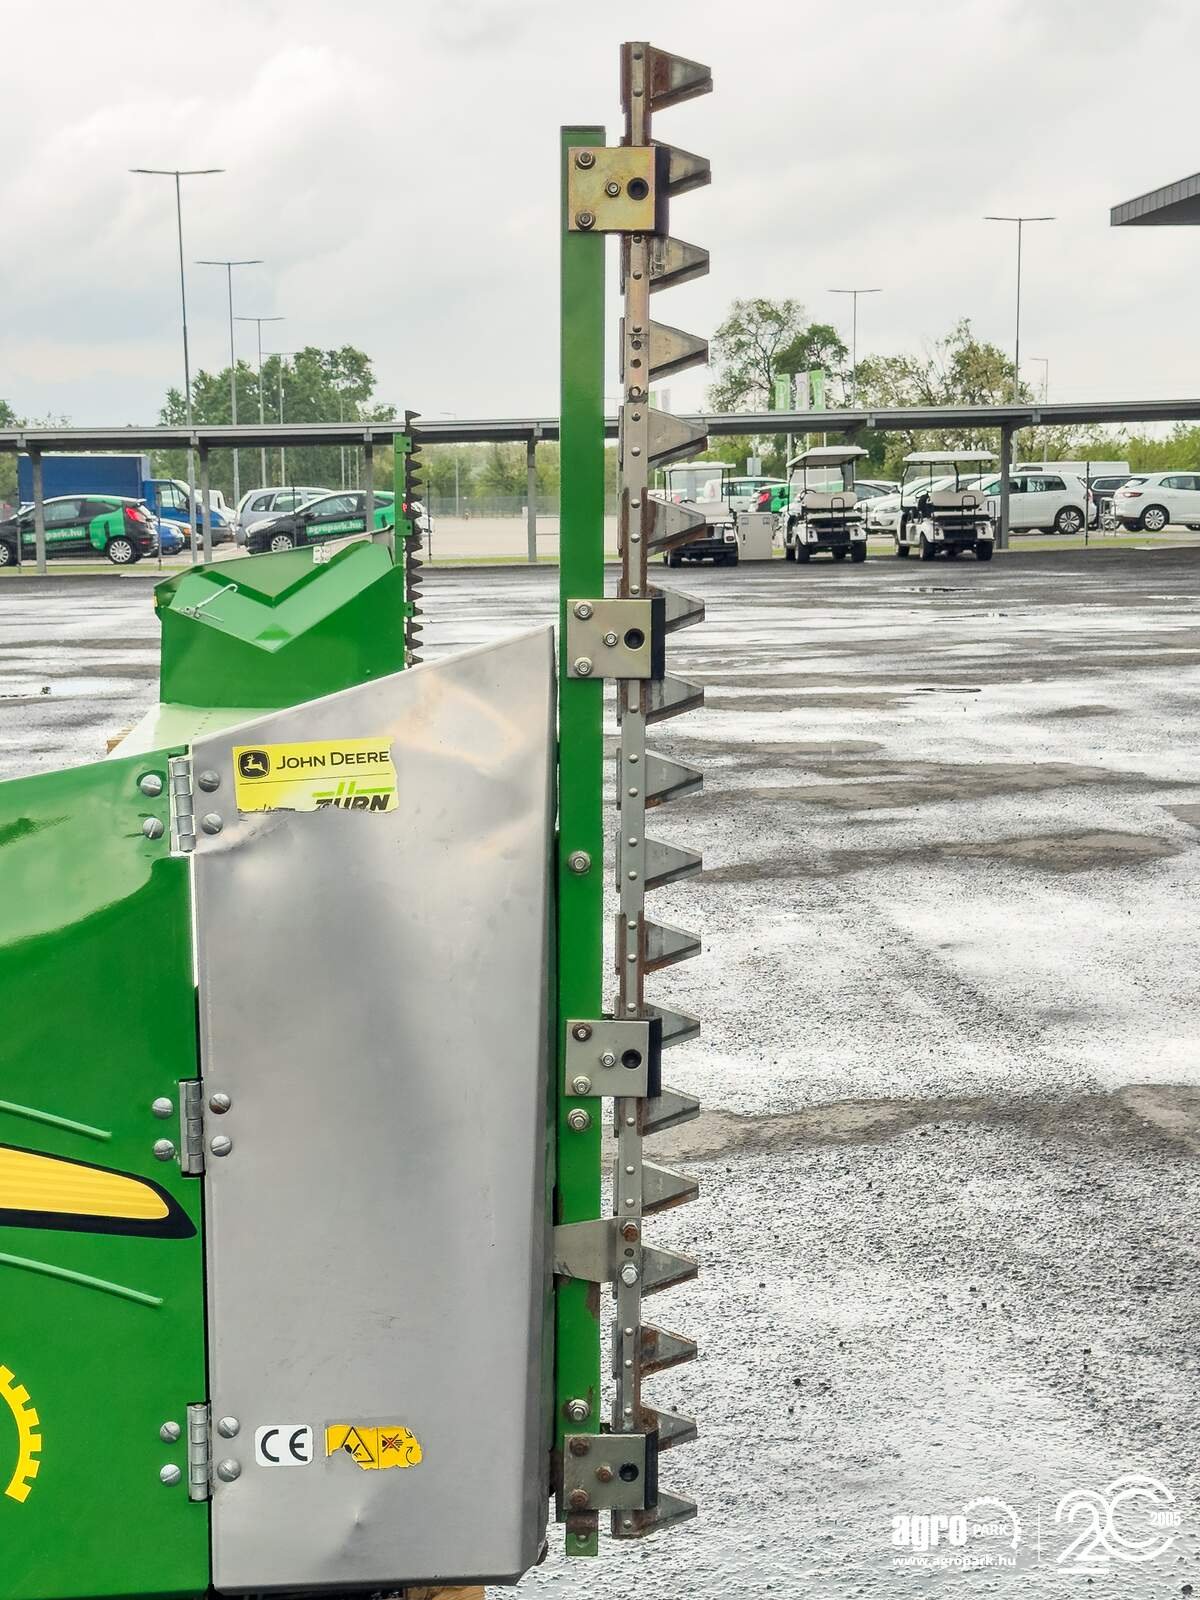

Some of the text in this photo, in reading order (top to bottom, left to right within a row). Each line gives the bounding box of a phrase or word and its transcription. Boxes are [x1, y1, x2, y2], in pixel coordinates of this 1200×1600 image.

[277, 751, 390, 770] JOHN DEERE
[252, 1429, 308, 1462] CE
